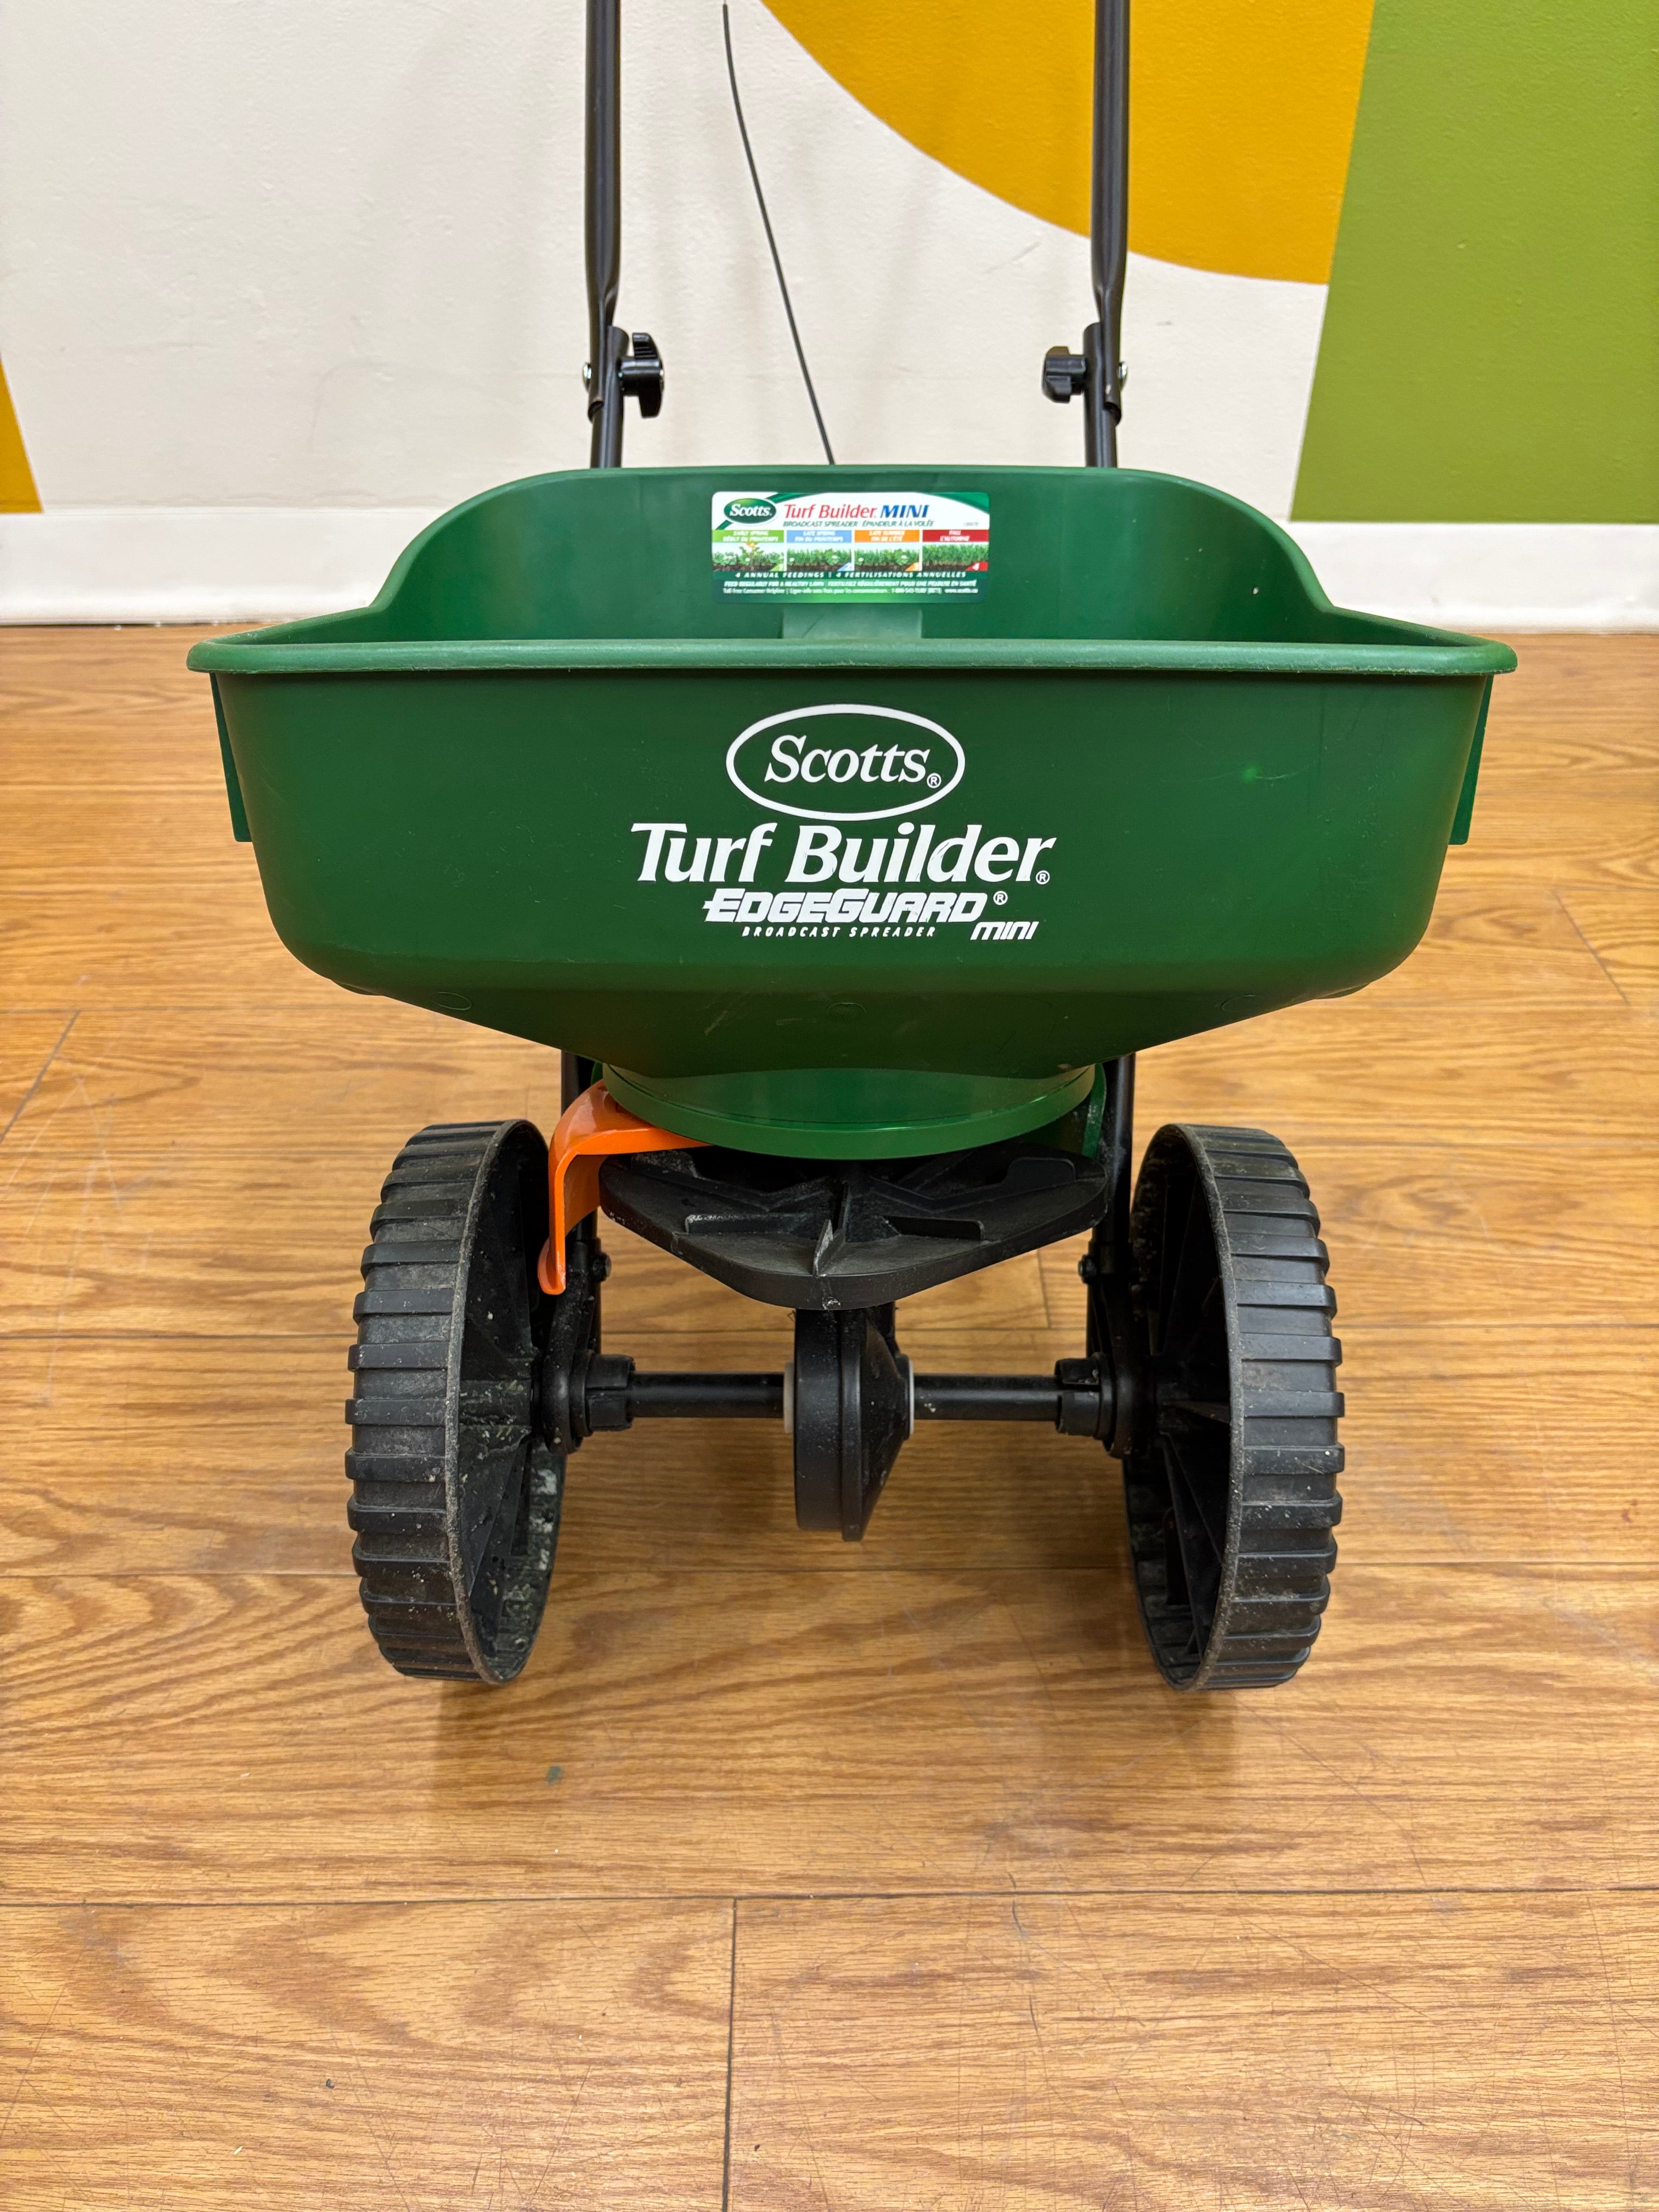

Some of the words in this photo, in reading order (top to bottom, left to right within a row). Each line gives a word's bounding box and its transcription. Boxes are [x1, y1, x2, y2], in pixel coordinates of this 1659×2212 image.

[730, 504, 770, 516] Scotts
[784, 504, 816, 518] Turf
[819, 504, 877, 518] Builder
[879, 505, 929, 518] MINI
[972, 562, 979, 571] 4
[630, 822, 778, 882] Turf
[742, 927, 841, 937] BROADCAST
[849, 927, 936, 937] SPREADER
